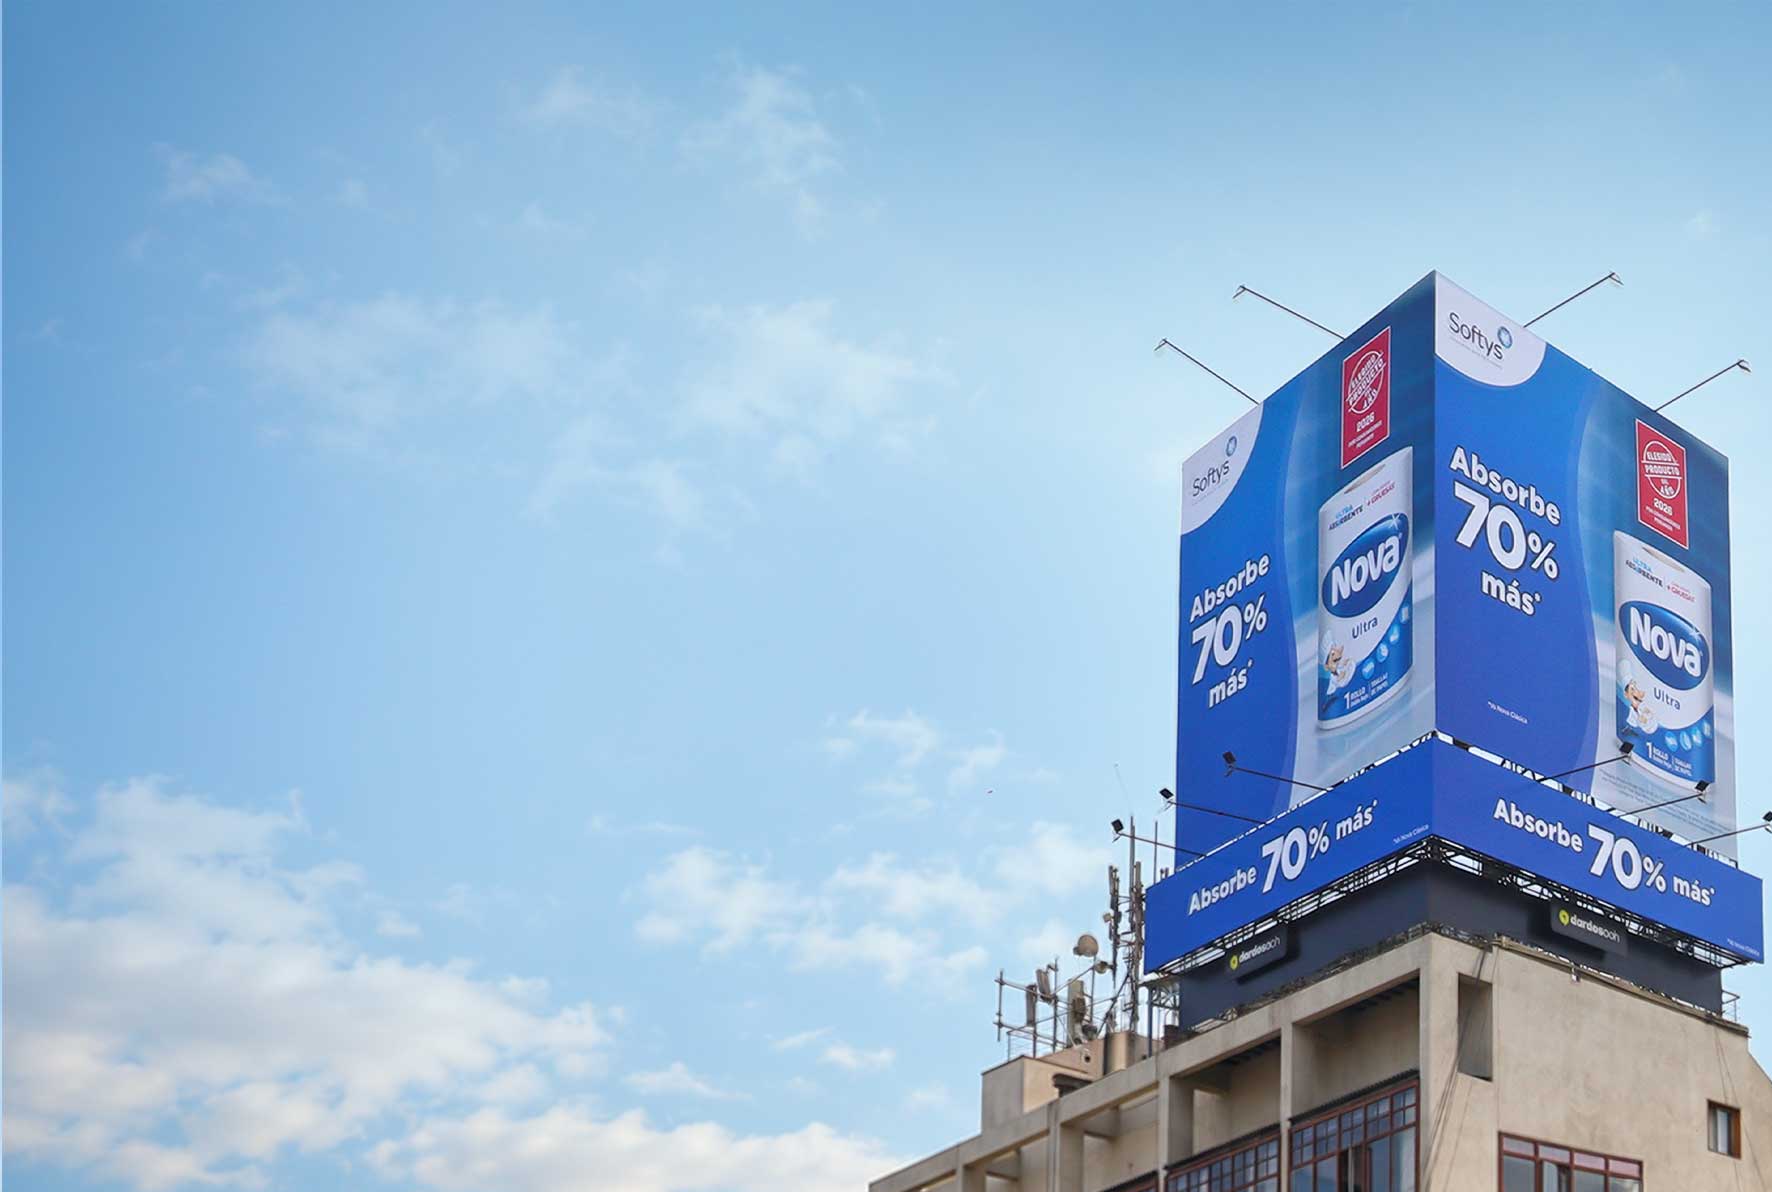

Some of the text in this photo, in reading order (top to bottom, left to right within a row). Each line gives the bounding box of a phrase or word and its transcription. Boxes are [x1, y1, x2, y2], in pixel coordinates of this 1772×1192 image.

[1449, 312, 1503, 360] Softys
[1192, 460, 1230, 497] Softys
[1450, 446, 1561, 525] Absorbe
[1645, 464, 1680, 475] PRODUCTO
[1454, 480, 1559, 579] 70%
[1189, 554, 1270, 623] Absorbe
[1331, 535, 1400, 606] Nova
[1192, 594, 1267, 685] 70%
[1352, 617, 1378, 639] Ultra
[1630, 606, 1701, 678] Nova
[1653, 687, 1681, 710] Ultra
[1188, 864, 1257, 915] Absorbe
[1262, 821, 1330, 893] 70%
[1493, 798, 1584, 852] Absorbe
[1587, 823, 1667, 892] 70%
[1570, 912, 1620, 943] dardosooh
